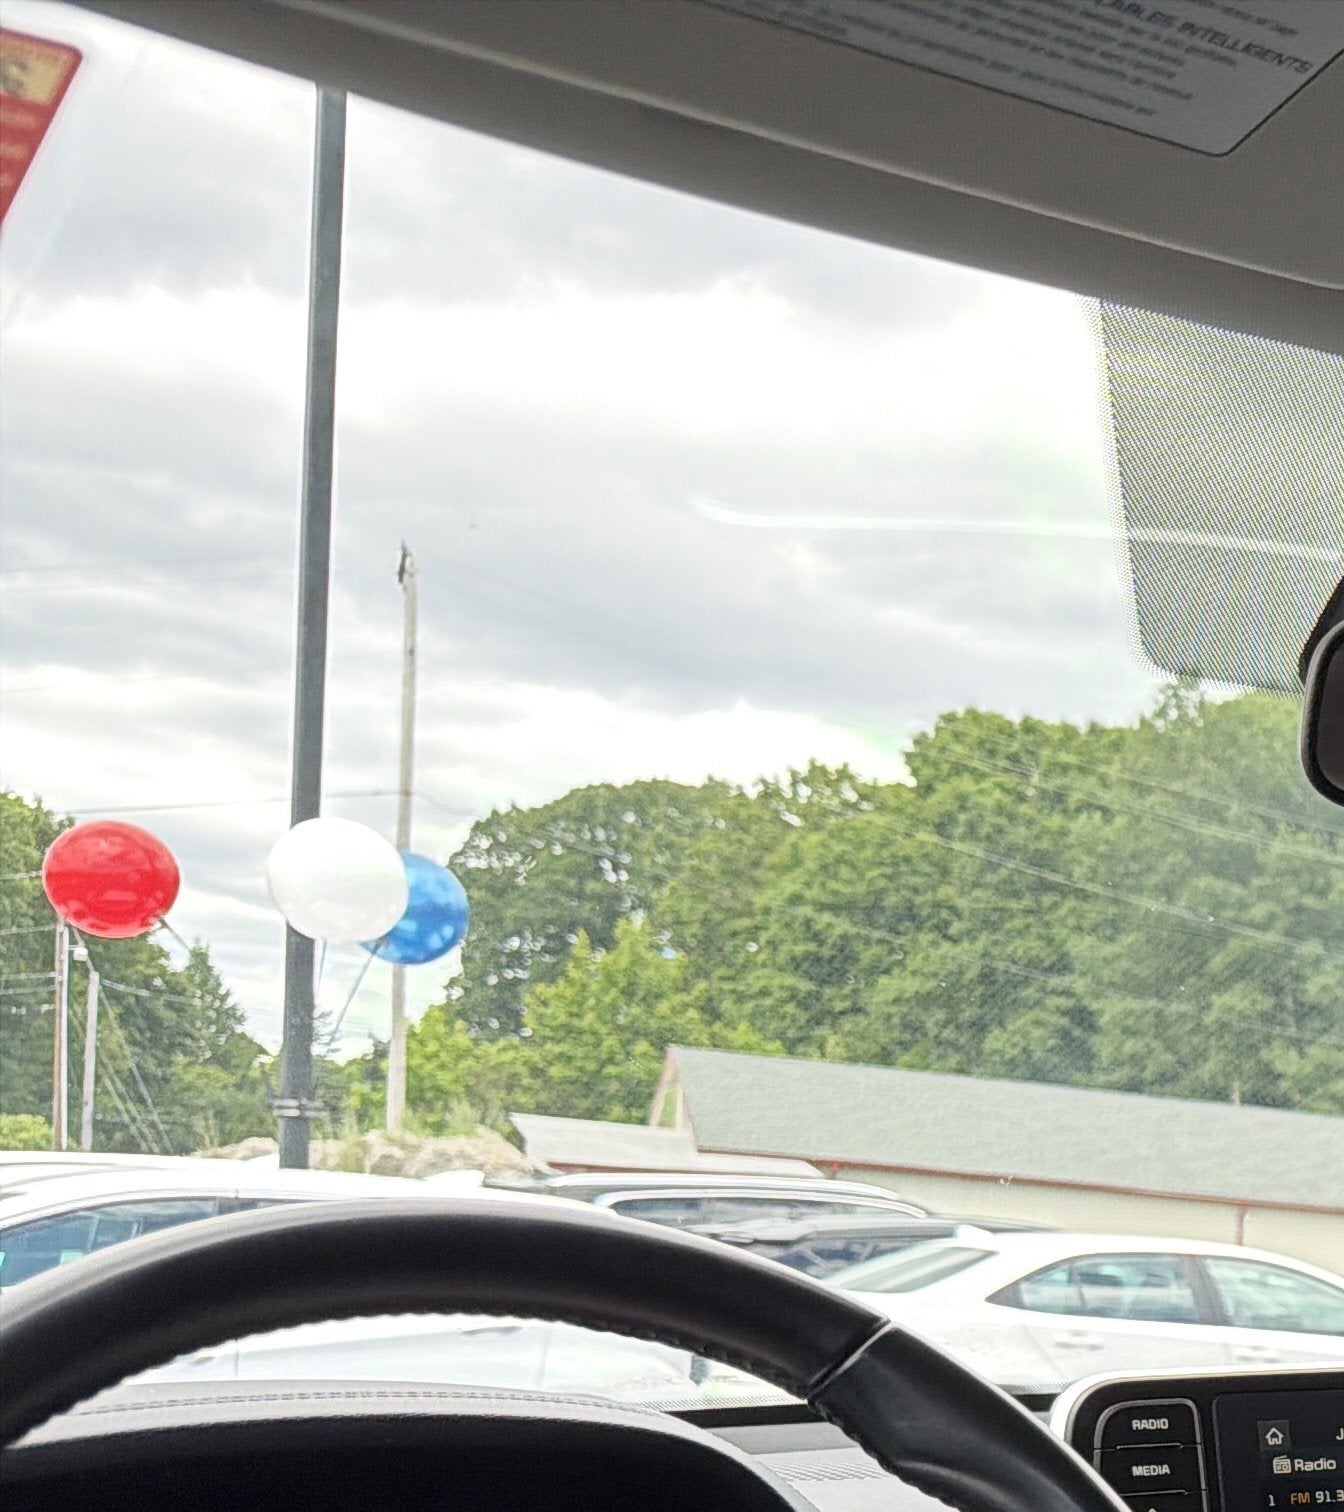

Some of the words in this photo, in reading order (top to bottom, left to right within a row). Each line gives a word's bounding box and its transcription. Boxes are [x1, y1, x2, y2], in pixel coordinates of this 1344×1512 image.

[1132, 1418, 1169, 1431] RADIO
[1132, 1464, 1171, 1477] MEDIA
[1294, 1457, 1337, 1472] Radio
[1268, 1495, 1276, 1506] 1
[1290, 1492, 1311, 1505] FM
[1315, 1489, 1344, 1503] 91.3
